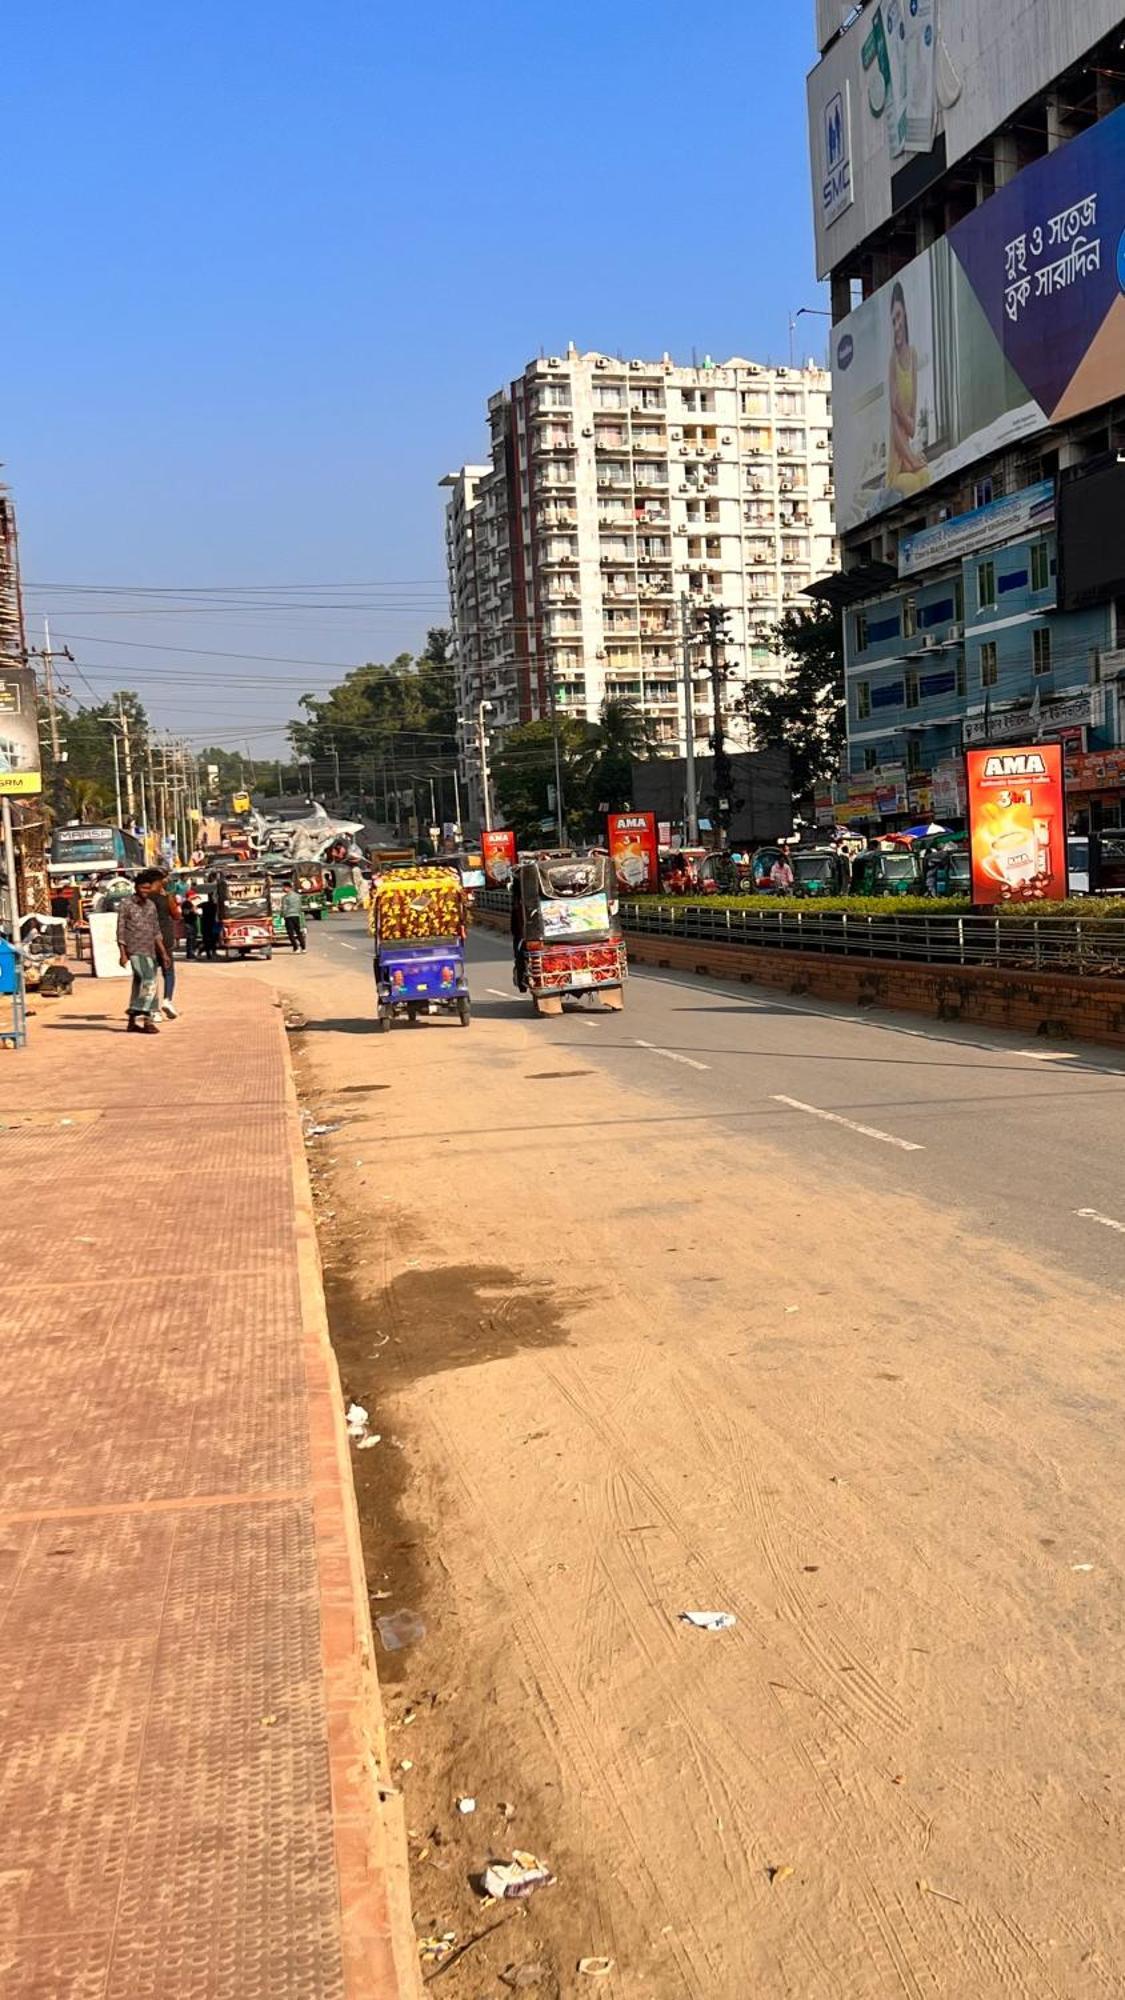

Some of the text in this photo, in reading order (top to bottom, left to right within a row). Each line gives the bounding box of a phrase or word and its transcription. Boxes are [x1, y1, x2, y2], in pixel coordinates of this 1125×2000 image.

[823, 161, 850, 208] SMC
[1005, 193, 1097, 280] সুস্থ ও সতেজ
[1005, 235, 1100, 322] ত্বক সারাদিন
[984, 753, 1046, 777] AMA
[488, 834, 509, 842] AMA
[617, 817, 647, 829] AMA
